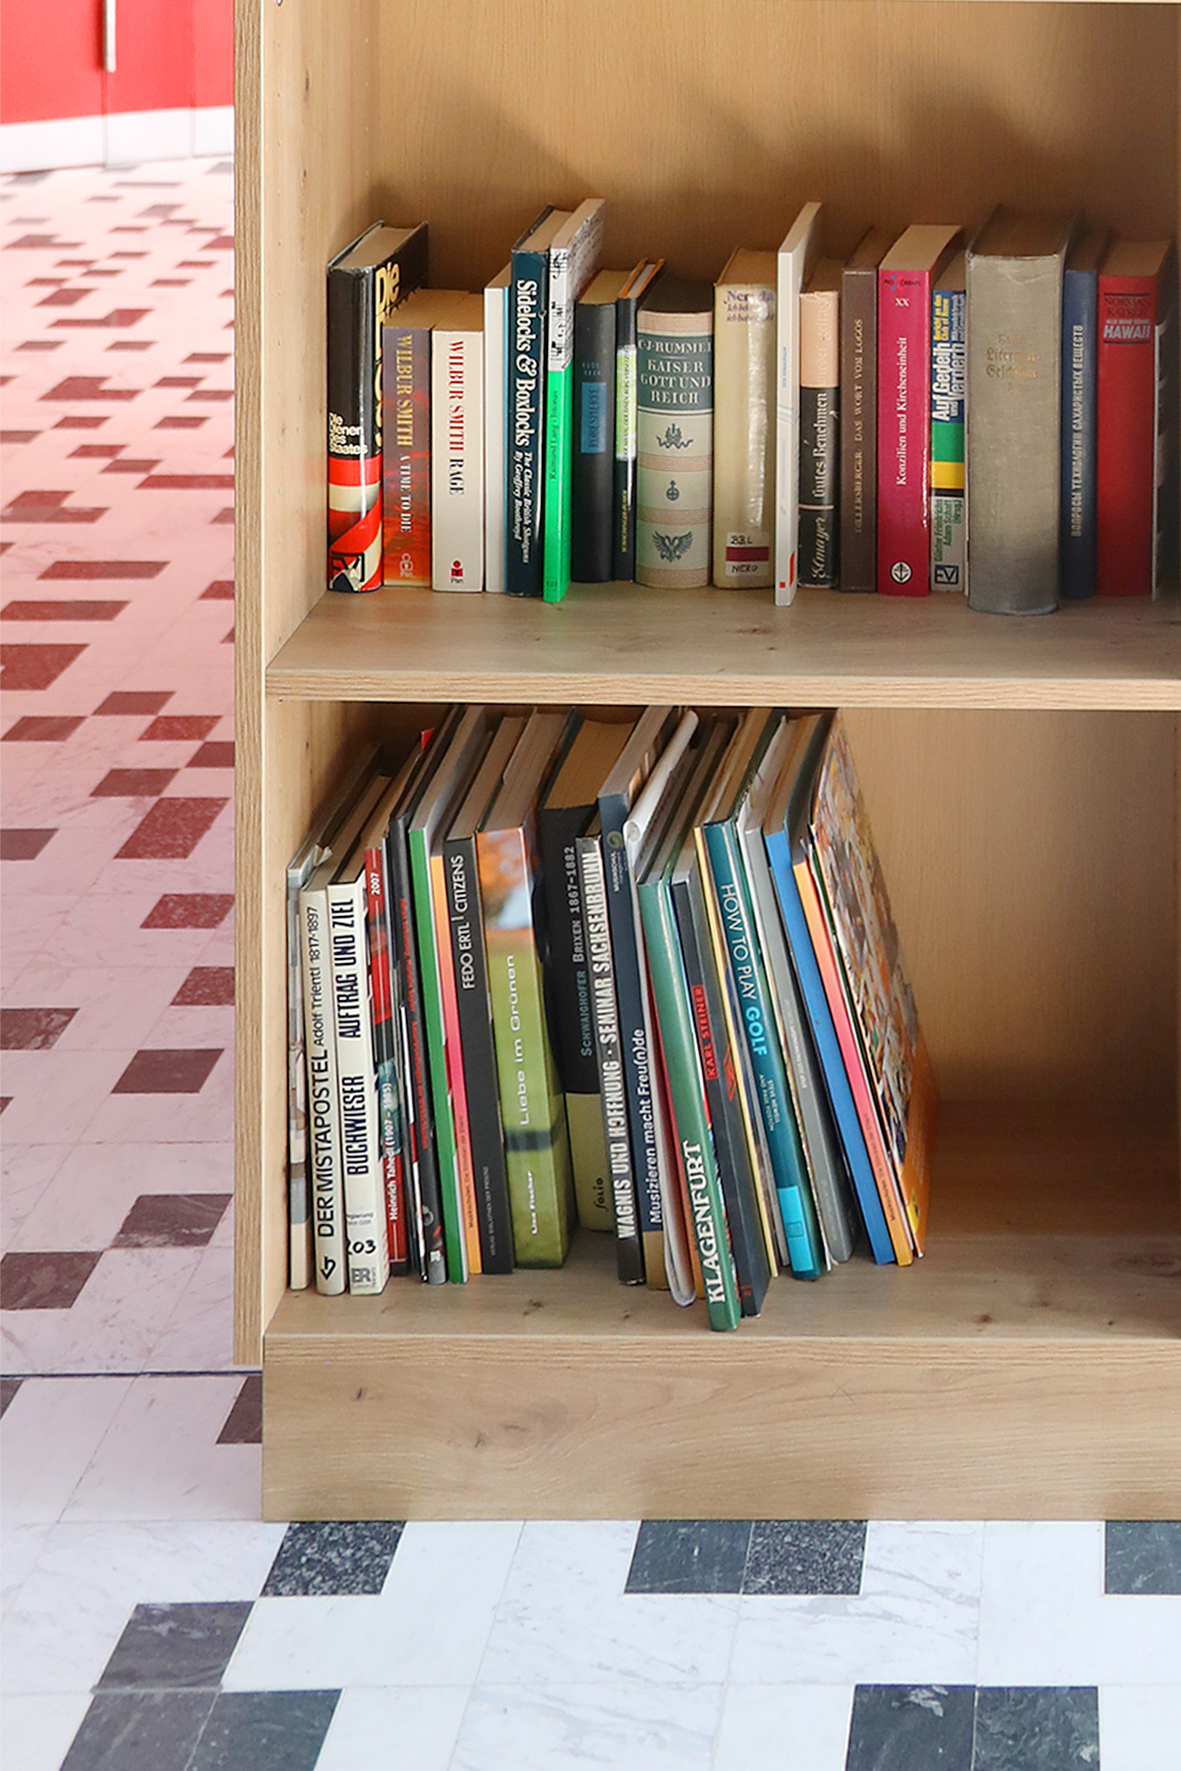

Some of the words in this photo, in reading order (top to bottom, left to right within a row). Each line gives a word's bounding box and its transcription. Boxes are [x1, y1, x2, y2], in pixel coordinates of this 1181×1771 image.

[515, 280, 539, 354] Sidelocks
[397, 335, 412, 396] WILBUR
[449, 341, 464, 404] WILBUR
[515, 355, 538, 380] &
[647, 360, 704, 371] KAISER
[896, 338, 907, 409] Kircheneinheit
[933, 342, 951, 394] Gedeih
[515, 379, 539, 446] Boxlocks
[651, 391, 699, 403] REICH
[897, 412, 907, 430] und
[932, 395, 949, 421] Auf
[397, 398, 412, 446] SMITH
[449, 405, 464, 451] SMITH
[449, 458, 464, 495] RAGE
[896, 433, 907, 486] Konzilien
[371, 873, 381, 896] 2007
[721, 884, 743, 932] HOW
[333, 898, 354, 929] ZIEL
[459, 920, 472, 949] ERTL
[583, 850, 610, 972] SACHSENBRUNN
[335, 931, 355, 969] UND
[462, 951, 476, 989] FEDO
[733, 935, 747, 961] TO
[507, 954, 521, 1033] Grünen
[738, 963, 757, 1000] PLAY
[335, 974, 359, 1038] AUFTRAG
[596, 976, 616, 1044] SEMINAR
[513, 1037, 525, 1063] im
[745, 1007, 768, 1055] GOLF
[633, 1029, 648, 1096] Freu(n)de
[513, 1070, 530, 1126] Liebe
[602, 1061, 628, 1129] HOFFNUNG
[311, 1049, 333, 1192] MISTAPOSTEL
[342, 1075, 368, 1176] BUCHWIESER
[639, 1099, 654, 1144] macht
[611, 1134, 631, 1174] UND
[387, 1178, 398, 1220] Heinrich
[615, 1178, 635, 1240] WAGNIS
[645, 1147, 662, 1223] Musizieren
[318, 1196, 334, 1237] DER
[684, 1142, 725, 1305] KLAGENFURT
